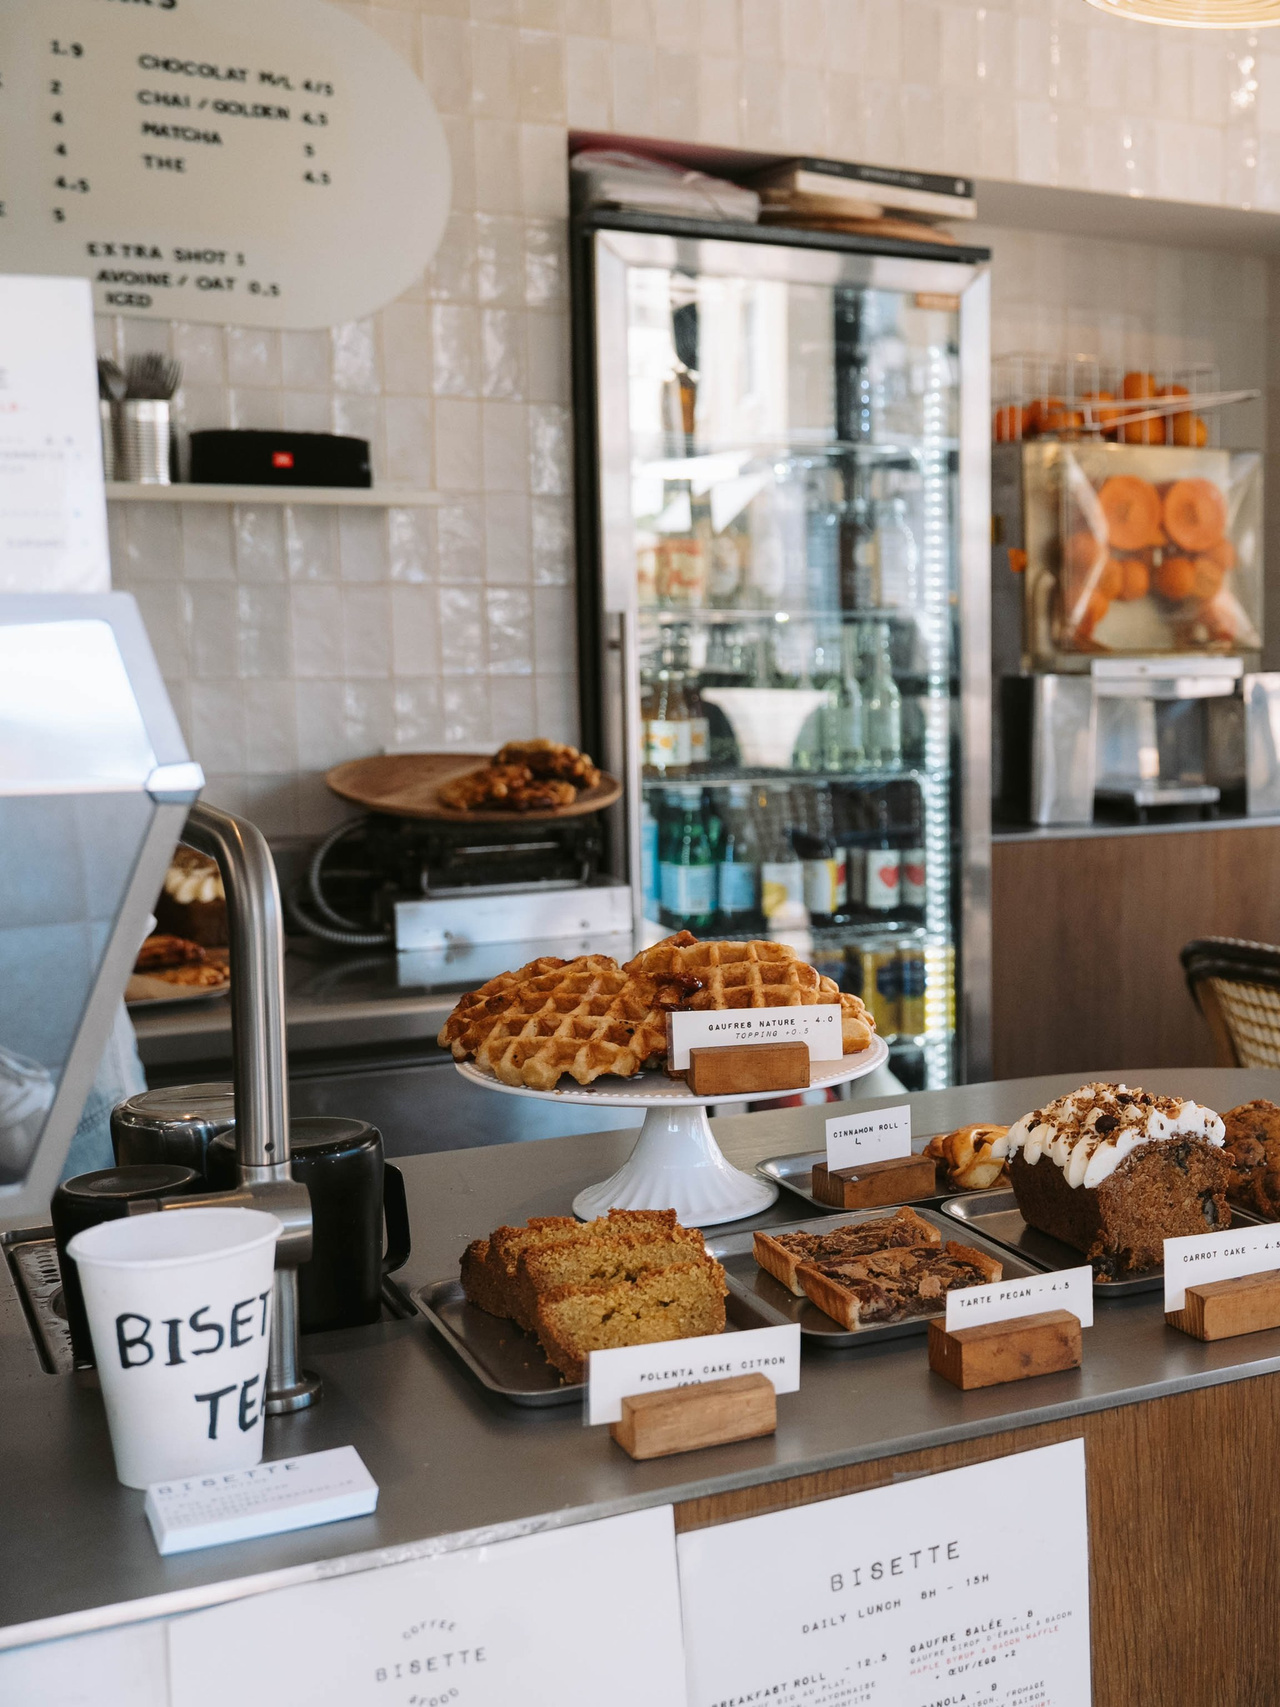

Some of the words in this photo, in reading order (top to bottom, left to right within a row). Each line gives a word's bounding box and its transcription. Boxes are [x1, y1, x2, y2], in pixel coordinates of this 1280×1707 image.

[137, 54, 248, 82] CHOCOLAT
[137, 89, 190, 108] CHAI
[141, 121, 224, 145] MATCHA
[55, 175, 91, 194] 4.5
[86, 241, 164, 262] EXTRA
[173, 246, 227, 266] SHOT
[97, 269, 172, 288] AVOINE
[195, 275, 236, 291] OAT
[248, 280, 281, 298] 0.5
[105, 291, 154, 308] ICED
[708, 1020, 752, 1032] GAUFRES
[759, 1017, 796, 1029] NATURE
[815, 1015, 834, 1024] 4.0
[735, 1030, 778, 1040] TOPPING
[785, 1027, 809, 1037] +0.5
[833, 1126, 874, 1138] CINNAMON
[879, 1122, 898, 1131] ROLL
[1183, 1250, 1218, 1263] CARROT
[1224, 1246, 1246, 1257] CAKE
[960, 1295, 992, 1307] TARTE
[1000, 1289, 1032, 1301] PECAN
[1051, 1281, 1070, 1291] 4.5
[640, 1368, 694, 1382] POLENTA
[703, 1362, 732, 1375] CAKE
[741, 1356, 786, 1369] CITRON
[158, 1460, 301, 1495] BISETTE
[830, 1541, 960, 1592] BISETTE
[802, 1613, 847, 1634] DAILY
[858, 1599, 902, 1619] LUNCH
[921, 1589, 936, 1600] 8H
[966, 1574, 989, 1587] 15H
[402, 1619, 457, 1640] COFFEE
[909, 1633, 957, 1654] GAUFRE
[965, 1618, 1003, 1637] SALÉE
[910, 1648, 945, 1665] GAUFRE
[951, 1638, 981, 1652] SIROP
[1045, 1610, 1073, 1625] BACON
[909, 1661, 940, 1676] MAPLE
[946, 1650, 975, 1664] SYRUP
[992, 1638, 1021, 1651] BACON
[1026, 1624, 1060, 1641] WAFFLE
[375, 1646, 487, 1682] BISETTE
[794, 1672, 826, 1688] ROLL
[857, 1653, 888, 1669] 12.5
[948, 1655, 998, 1677] ŒUF/EGG
[815, 1680, 877, 1705] MAYONNAISE
[991, 1683, 997, 1692] 9
[1006, 1680, 1045, 1698] FROMAGE
[1012, 1691, 1046, 1707] SAISON
